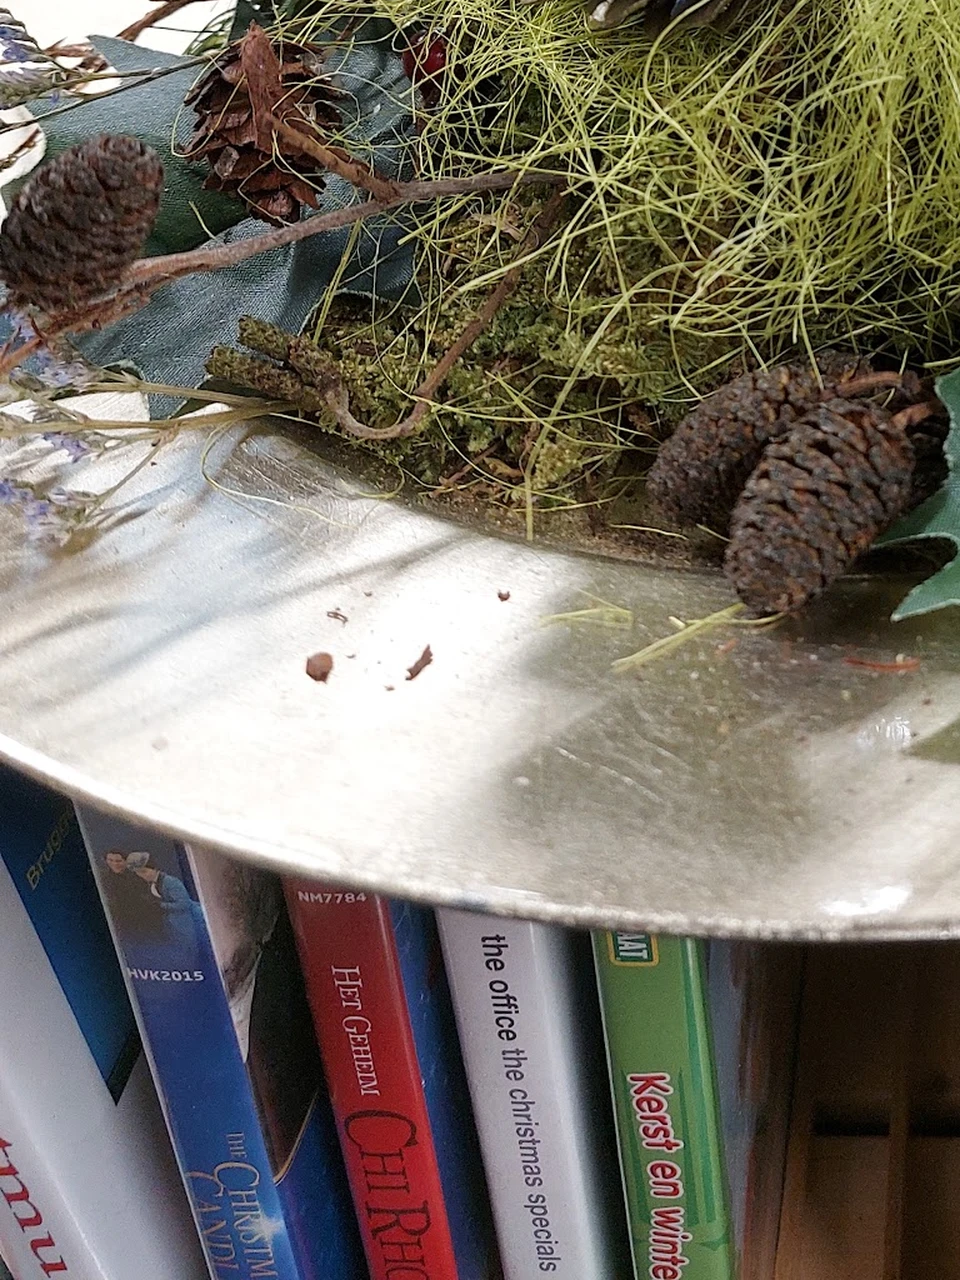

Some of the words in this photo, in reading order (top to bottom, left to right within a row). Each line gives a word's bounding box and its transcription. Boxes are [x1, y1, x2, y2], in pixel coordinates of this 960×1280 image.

[297, 891, 367, 904] NM7784
[126, 967, 204, 982] HVK2015
[481, 934, 508, 971] the
[331, 965, 362, 1010] HET
[489, 980, 519, 1041] office
[342, 1015, 380, 1096] GEHEIM
[502, 1048, 528, 1081] the
[627, 1073, 684, 1153] Kerst
[225, 1131, 248, 1158] THE
[344, 1109, 419, 1194] CHI
[509, 1088, 543, 1187] christmas
[647, 1160, 684, 1198] en
[524, 1193, 561, 1272] specials
